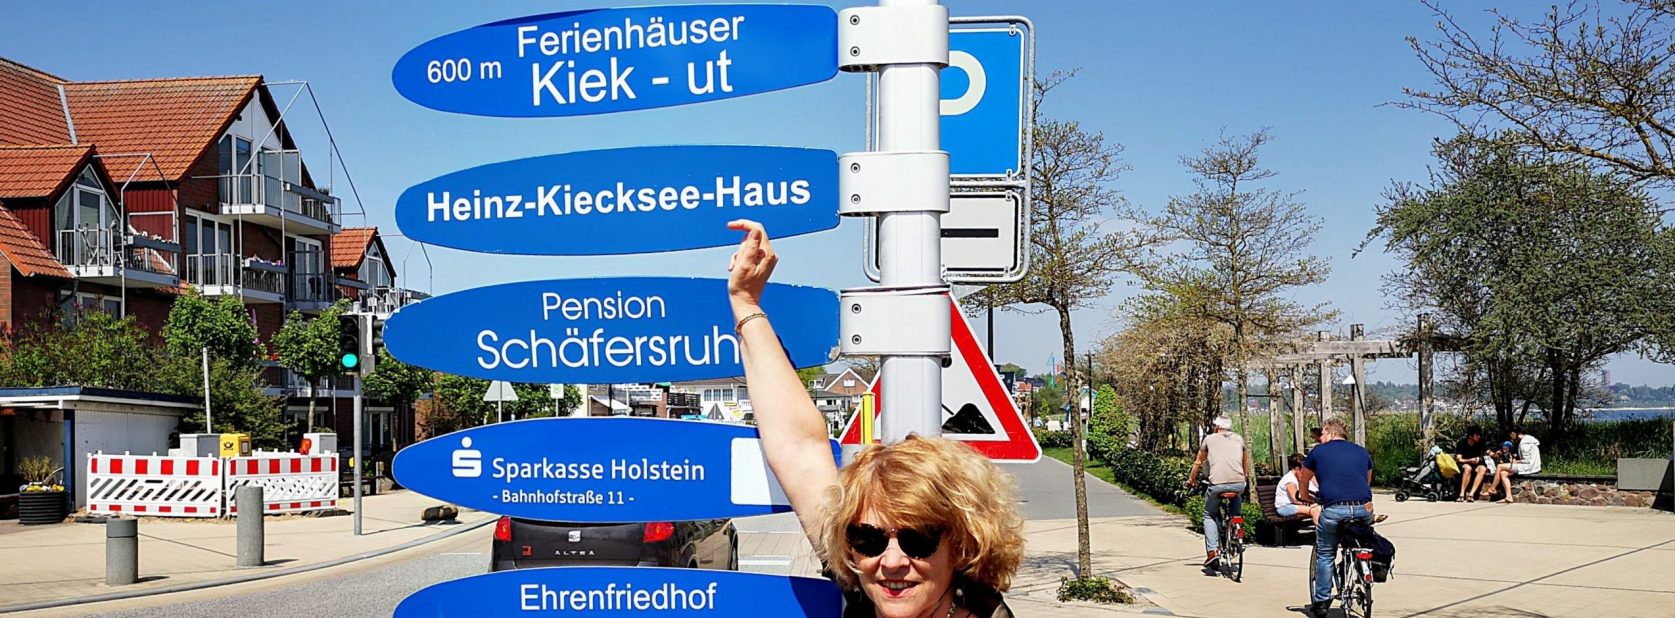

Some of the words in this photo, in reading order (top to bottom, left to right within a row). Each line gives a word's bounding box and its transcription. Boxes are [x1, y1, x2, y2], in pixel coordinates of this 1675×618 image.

[517, 16, 745, 57] Ferienhäuser
[427, 58, 472, 83] 600
[480, 61, 502, 80] m
[532, 57, 637, 106] Kiek
[687, 49, 733, 95] ut
[427, 176, 811, 222] Heinz-Kiecksee-Haus
[542, 290, 666, 321] Pension
[477, 325, 740, 369] Schäfersruh
[492, 457, 604, 483] Sparkasse
[611, 458, 705, 480] Holstein
[502, 489, 604, 505] Bahnhofstraße
[608, 491, 624, 505] 11
[520, 582, 718, 611] Ehrenfriedhof
